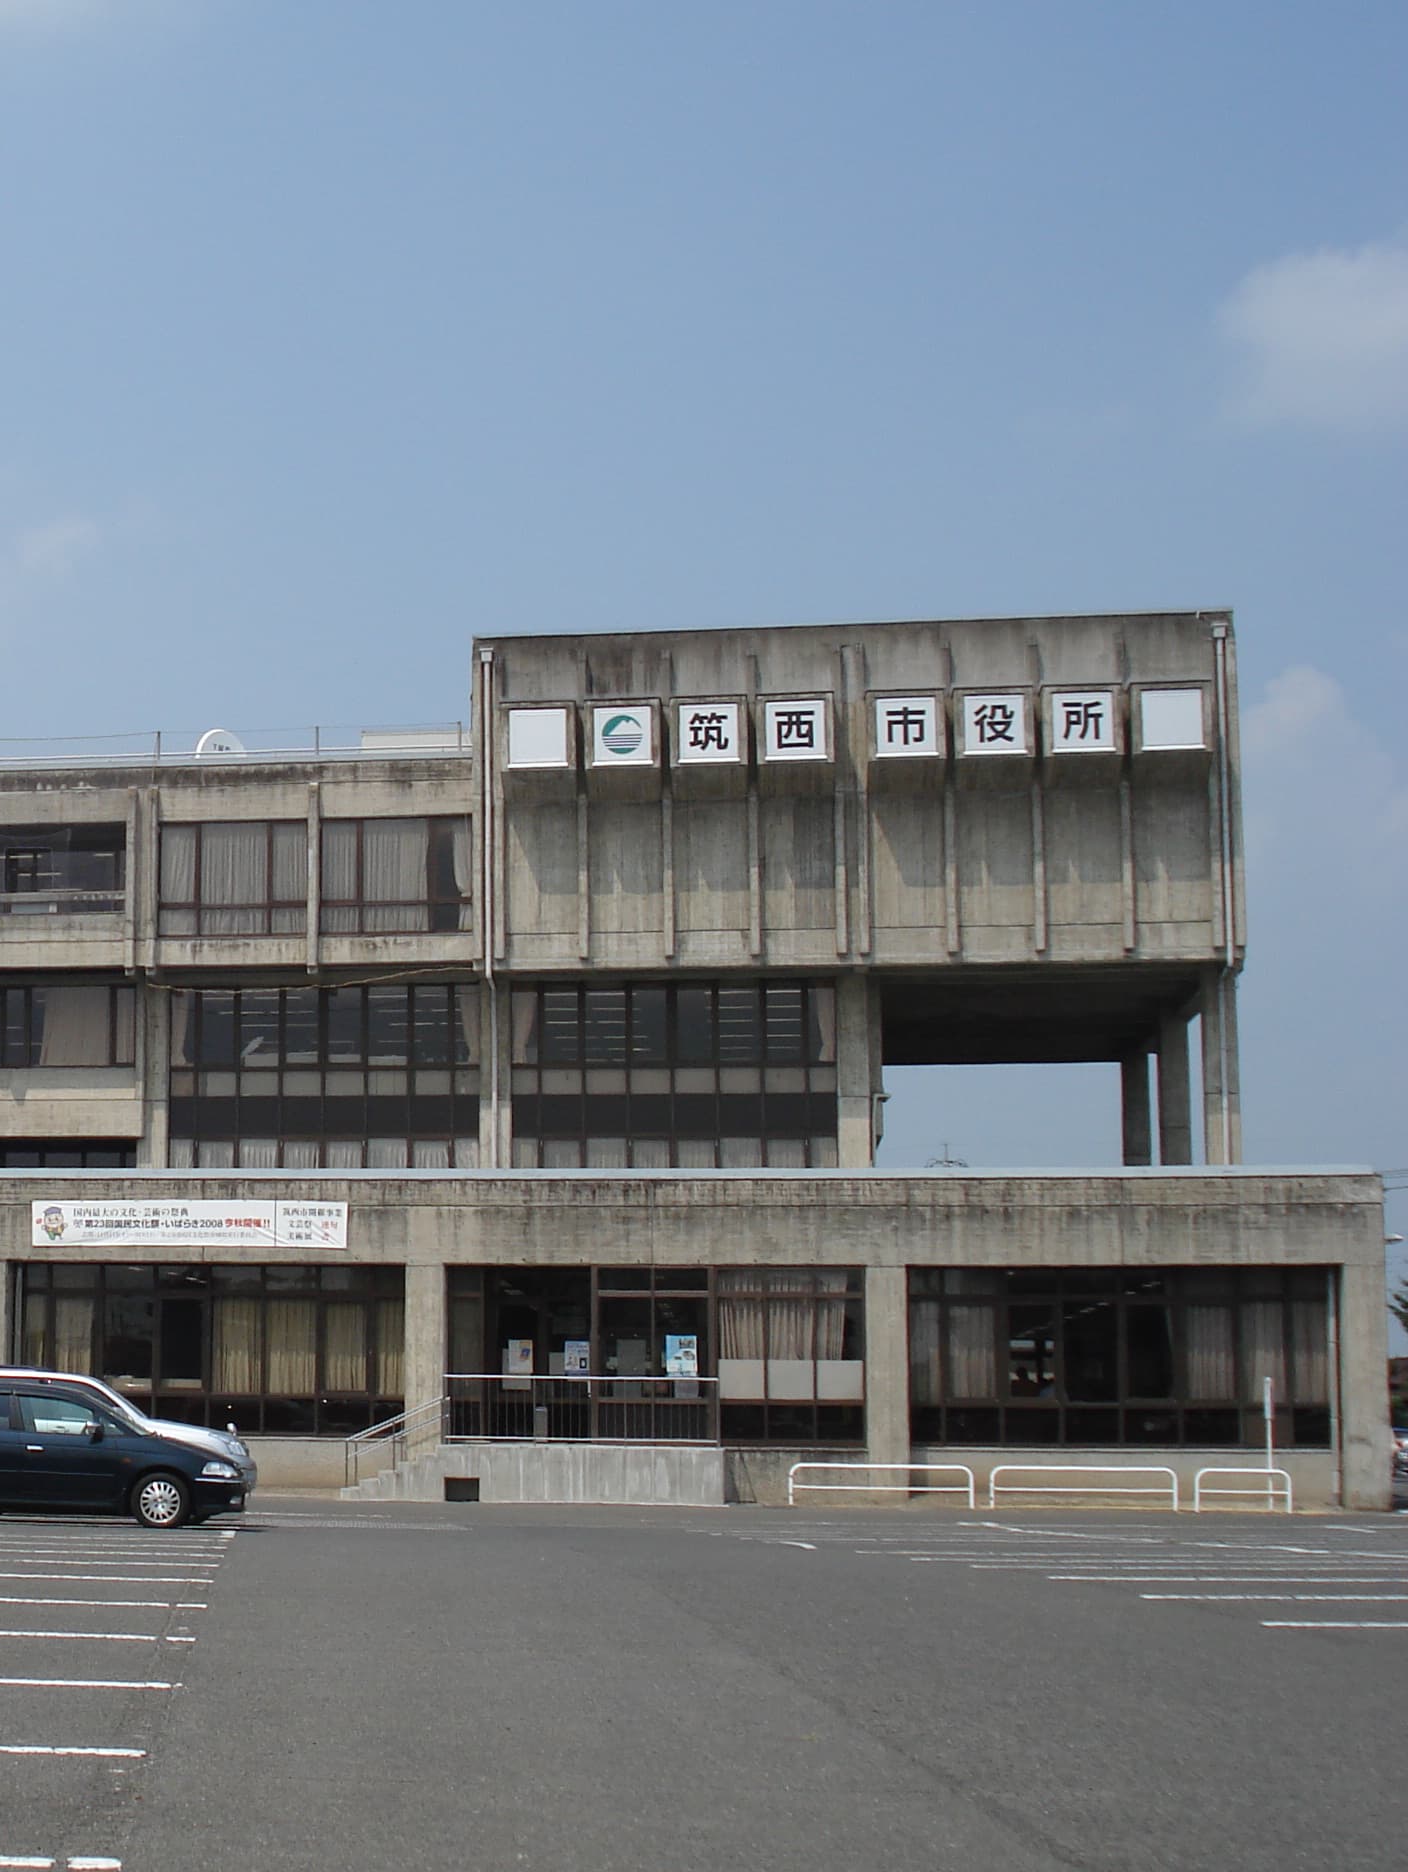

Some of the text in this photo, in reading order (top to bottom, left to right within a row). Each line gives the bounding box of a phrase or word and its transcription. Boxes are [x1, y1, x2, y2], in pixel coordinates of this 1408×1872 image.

[688, 701, 1104, 752] 筑西市役所
